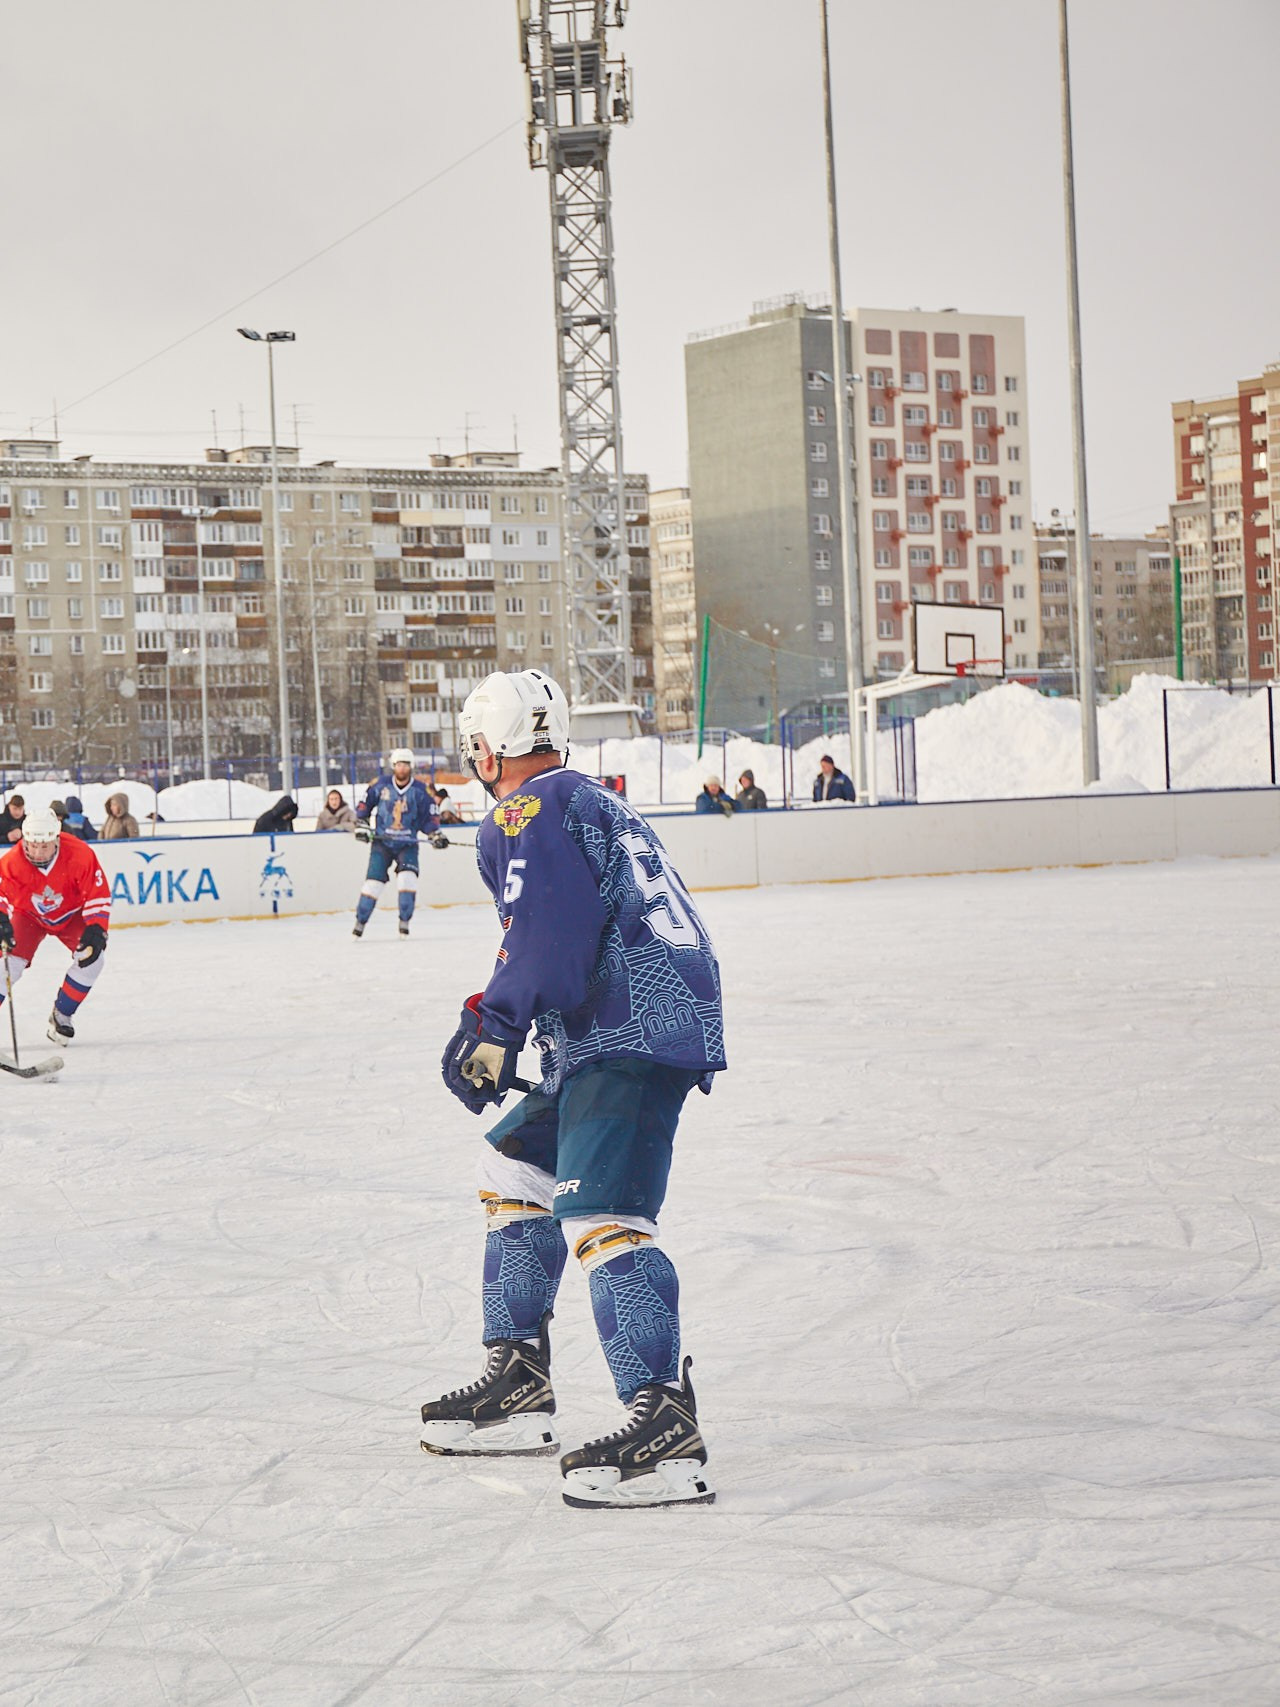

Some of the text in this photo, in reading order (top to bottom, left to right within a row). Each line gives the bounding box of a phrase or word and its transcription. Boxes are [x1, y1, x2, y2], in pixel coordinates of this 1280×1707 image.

[532, 711, 549, 732] Z
[95, 869, 103, 887] 3
[111, 851, 220, 906] АЙКА
[504, 858, 527, 904] 5
[499, 1379, 536, 1411] CCM
[632, 1422, 685, 1464] CCM
